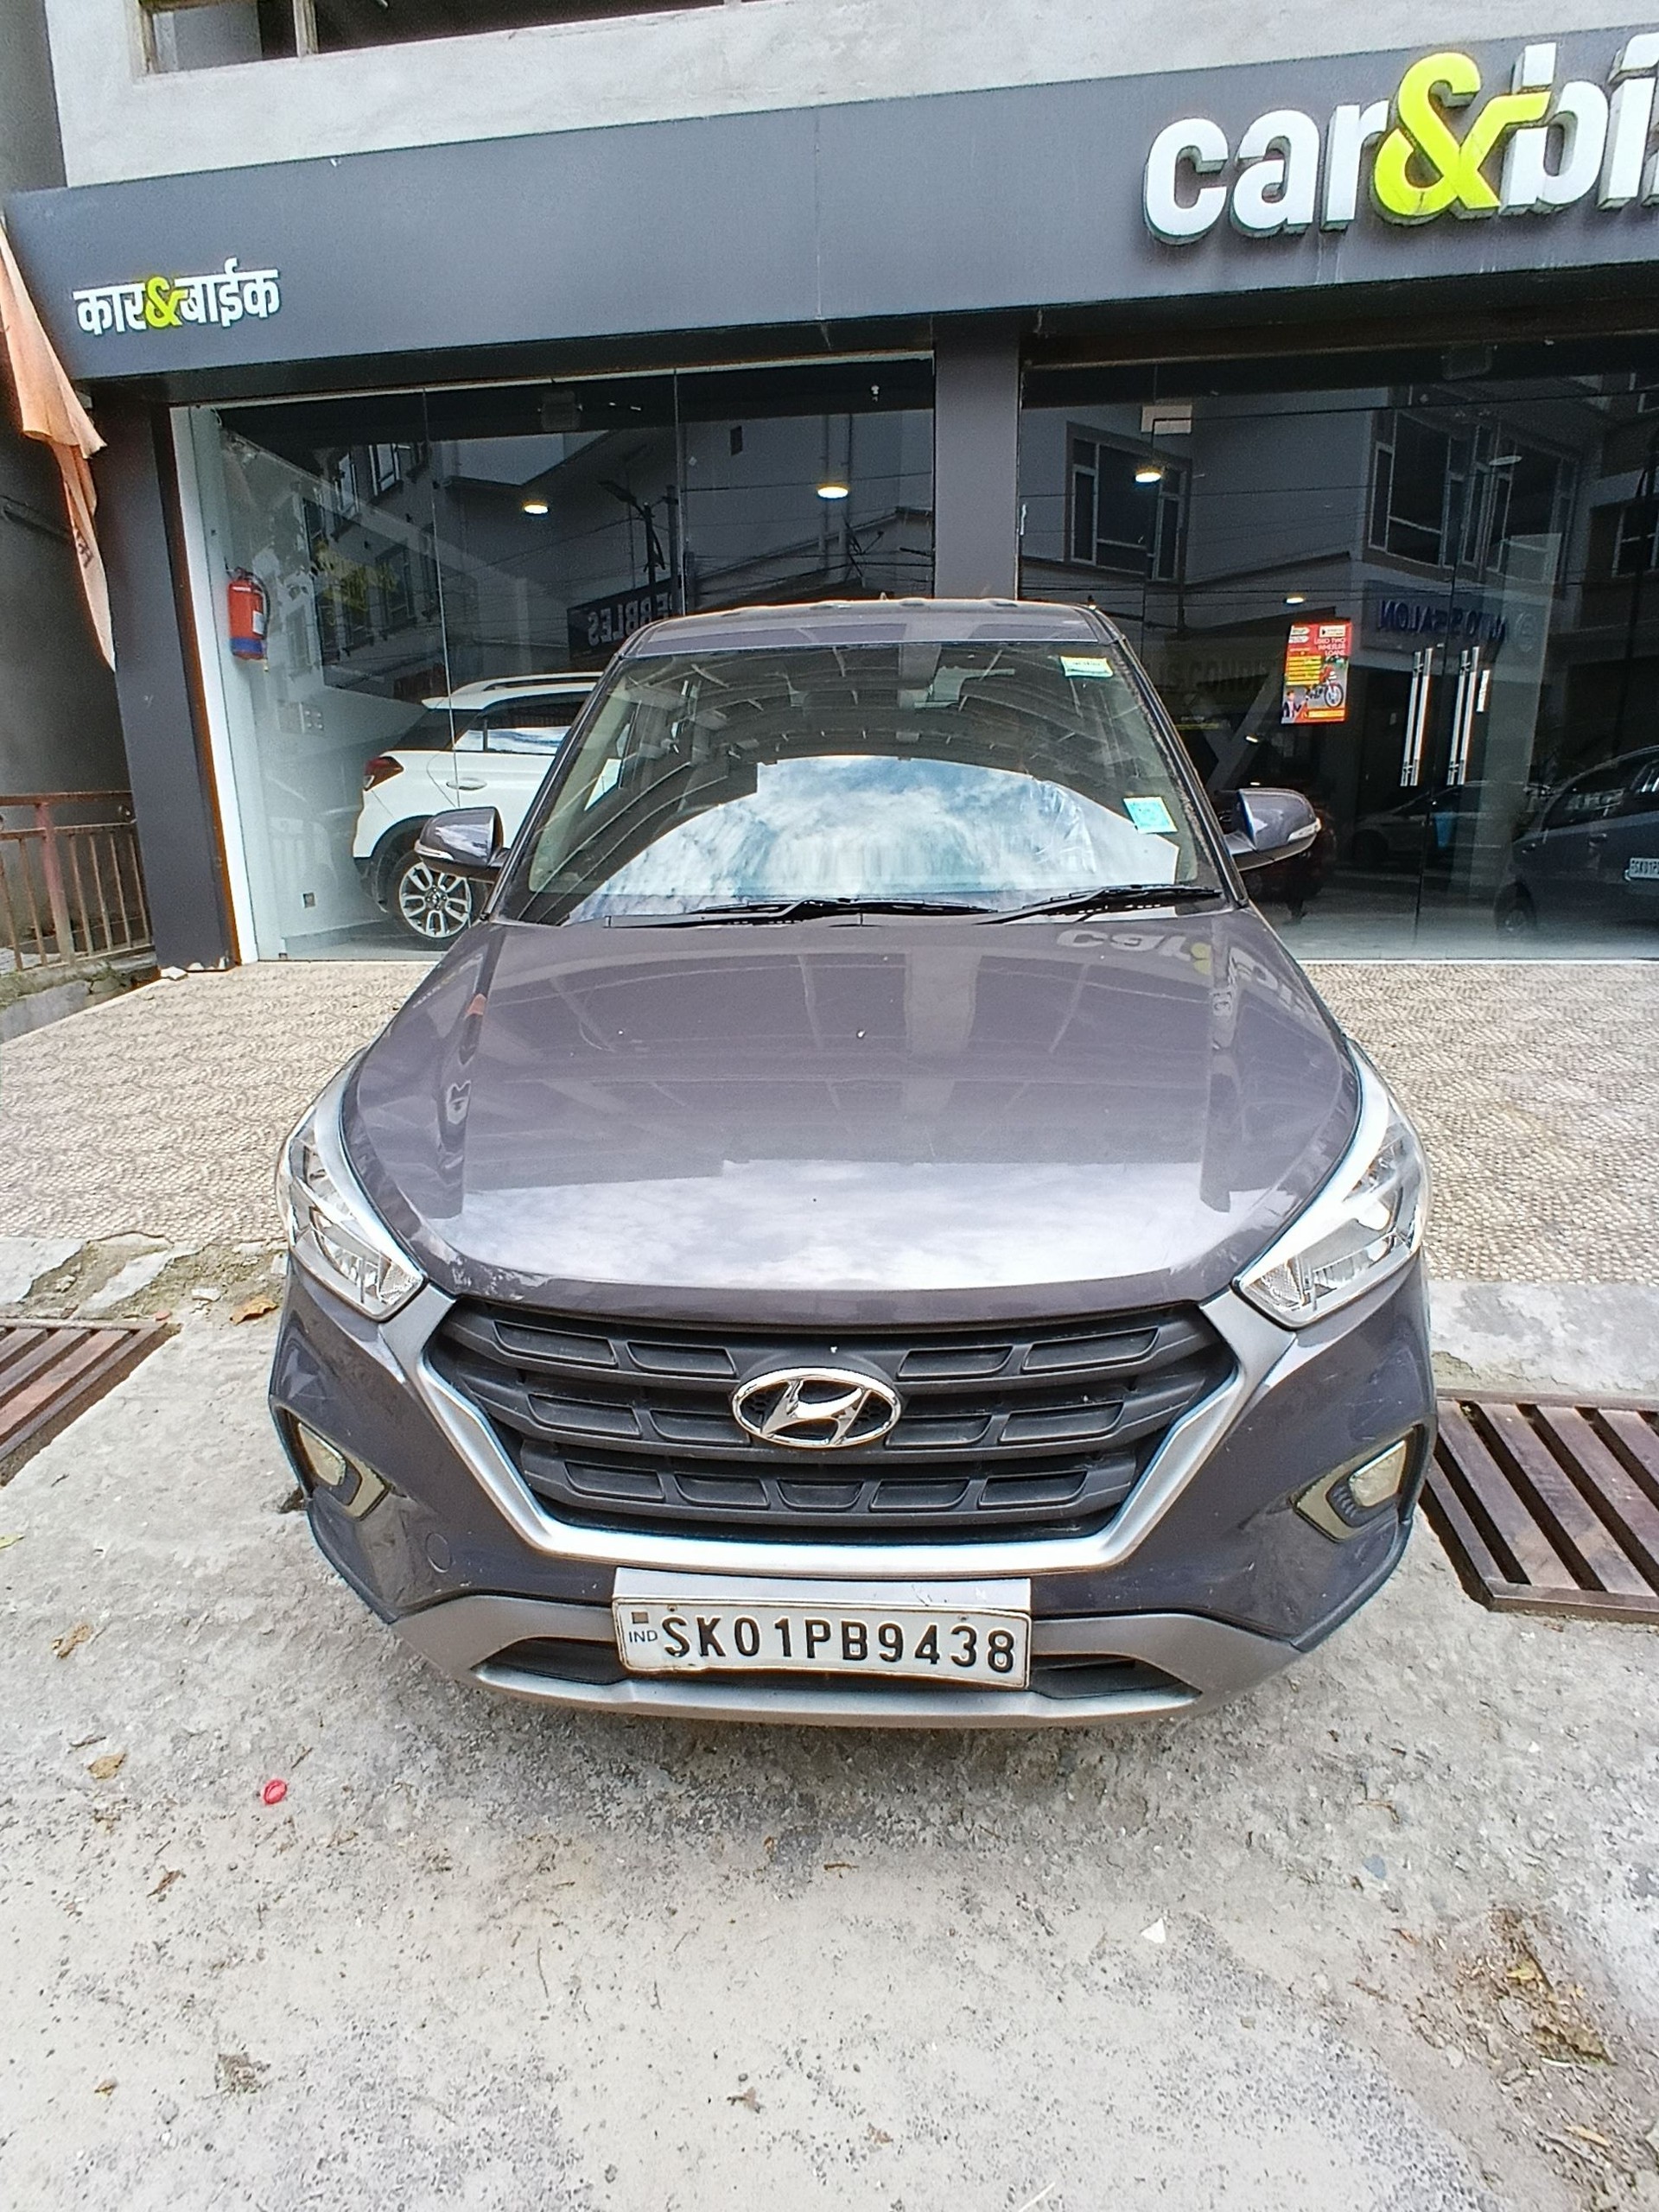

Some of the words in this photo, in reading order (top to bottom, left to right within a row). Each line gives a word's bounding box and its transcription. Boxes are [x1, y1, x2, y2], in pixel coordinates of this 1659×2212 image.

[1143, 31, 1659, 245] car&bi
[73, 257, 282, 335] कार&बाईक
[628, 1629, 658, 1643] IND
[661, 1616, 1015, 1674] SK01PB9438
